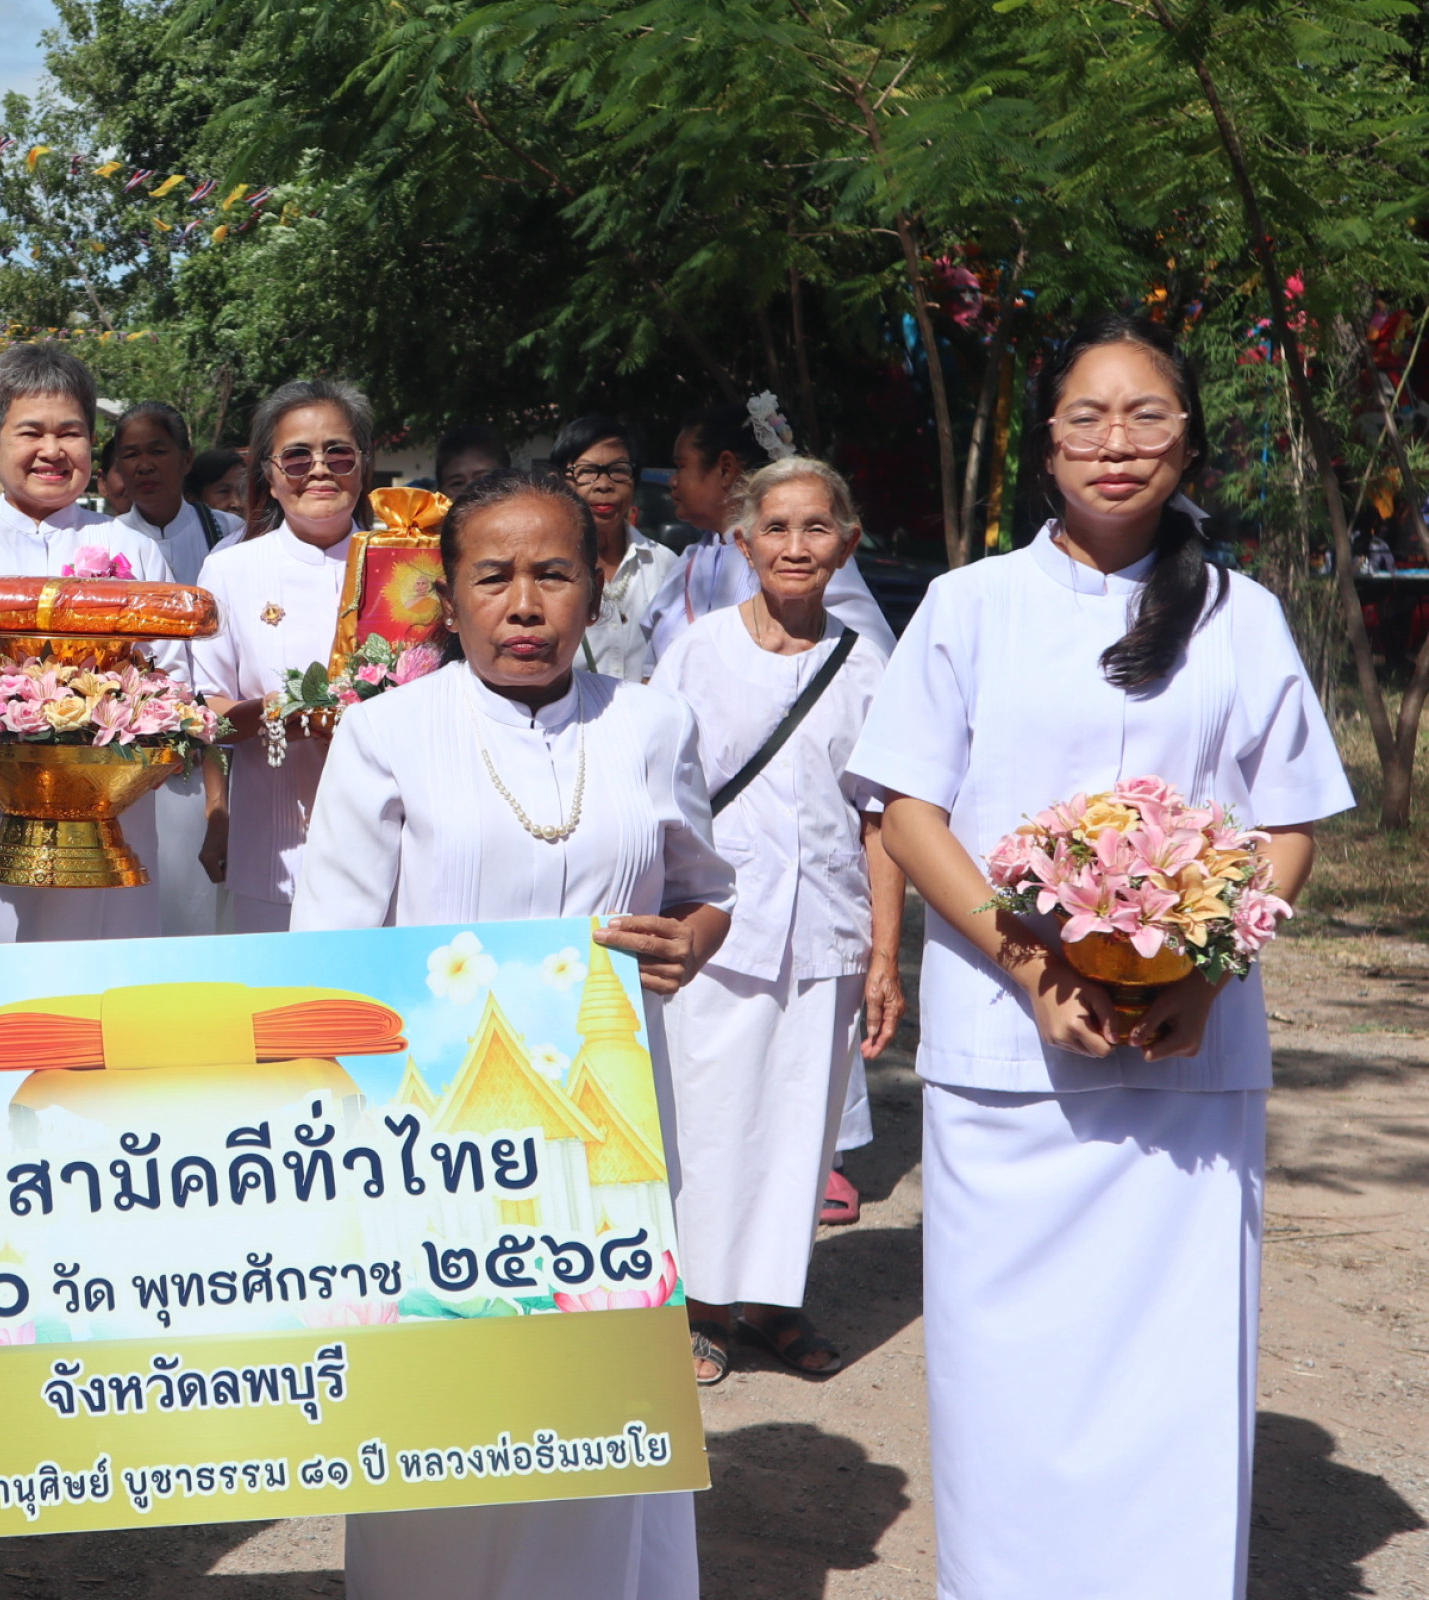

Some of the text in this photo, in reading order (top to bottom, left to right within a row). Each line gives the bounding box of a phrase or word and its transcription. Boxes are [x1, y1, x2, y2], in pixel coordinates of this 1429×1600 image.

[52, 1261, 116, 1314] วัด
[132, 1251, 403, 1329] พุทธศักราช
[420, 1227, 655, 1293] ๒๕๖๘
[44, 1344, 347, 1421] จังหวัดลพบุรี
[124, 1461, 287, 1510] บูชาธรรม
[300, 1458, 349, 1486] ๘๑
[361, 1442, 386, 1481] ปี
[399, 1425, 669, 1479] หลวงพ่อธัมมชโย
